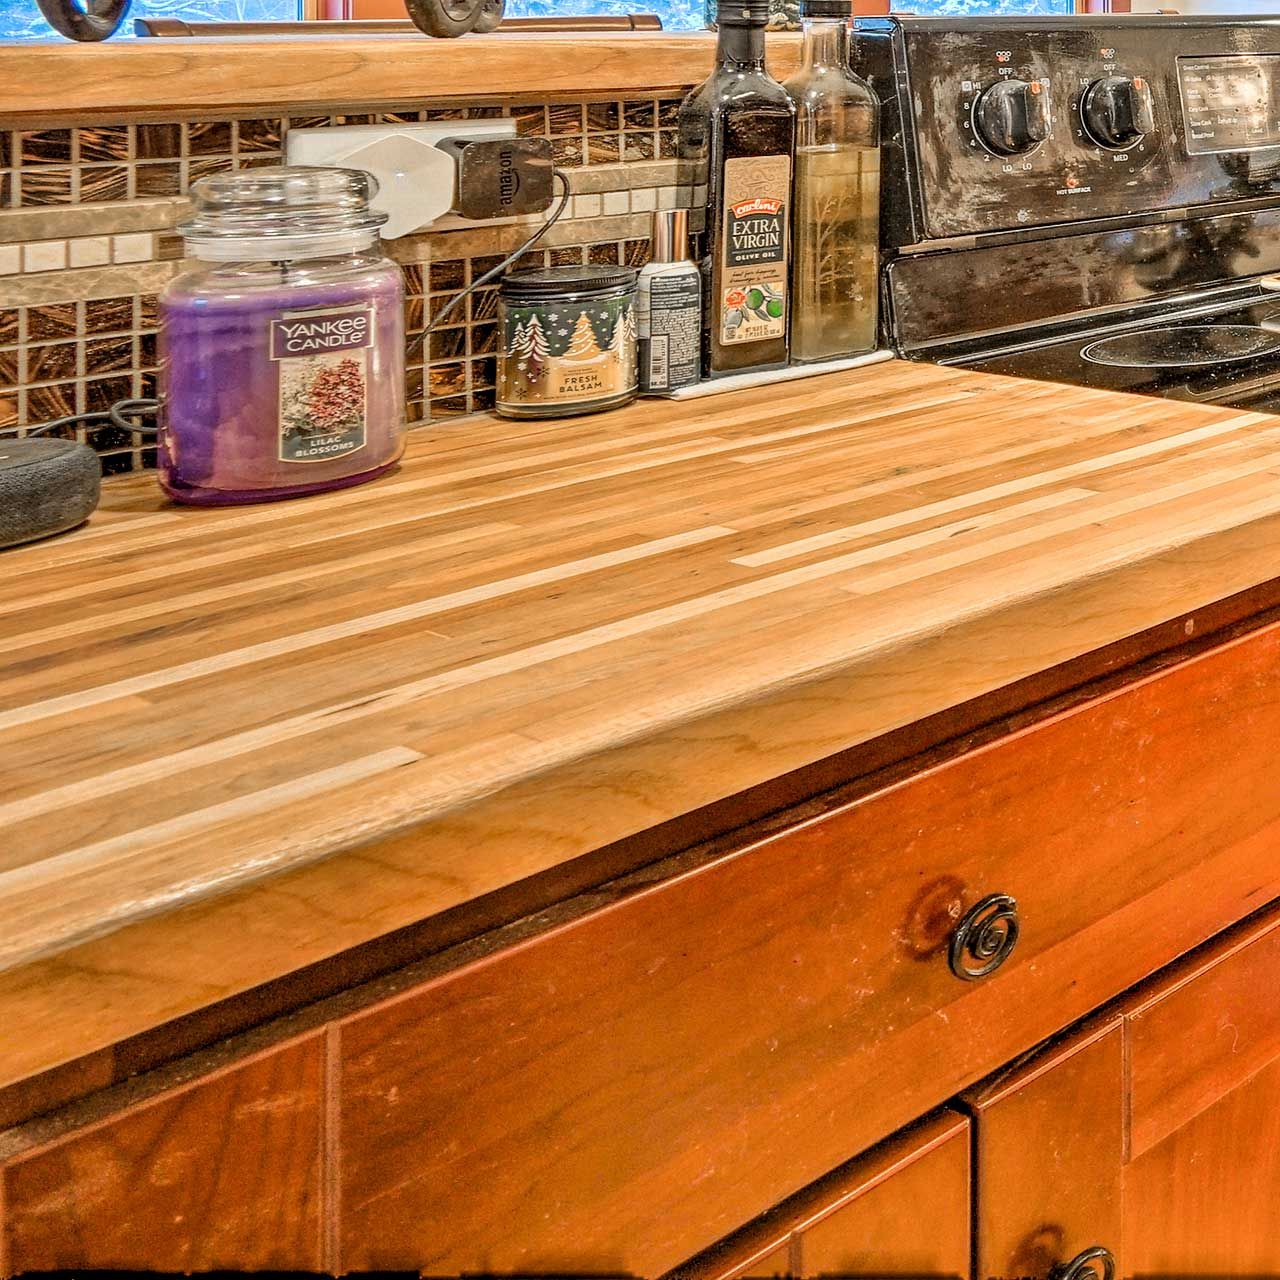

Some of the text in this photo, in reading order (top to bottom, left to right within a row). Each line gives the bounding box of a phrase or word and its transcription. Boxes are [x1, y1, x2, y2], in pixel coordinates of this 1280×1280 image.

[998, 67, 1013, 75] OFF
[1113, 154, 1129, 162] MED
[500, 150, 513, 206] amazon
[732, 218, 780, 236] EXTRA
[732, 232, 780, 249] VIRGIN
[735, 252, 760, 261] OLIVE
[564, 375, 598, 385] FRESH
[559, 382, 602, 393] BALSAM
[310, 435, 343, 447] LILAC
[295, 441, 354, 458] BLOSSOMS
